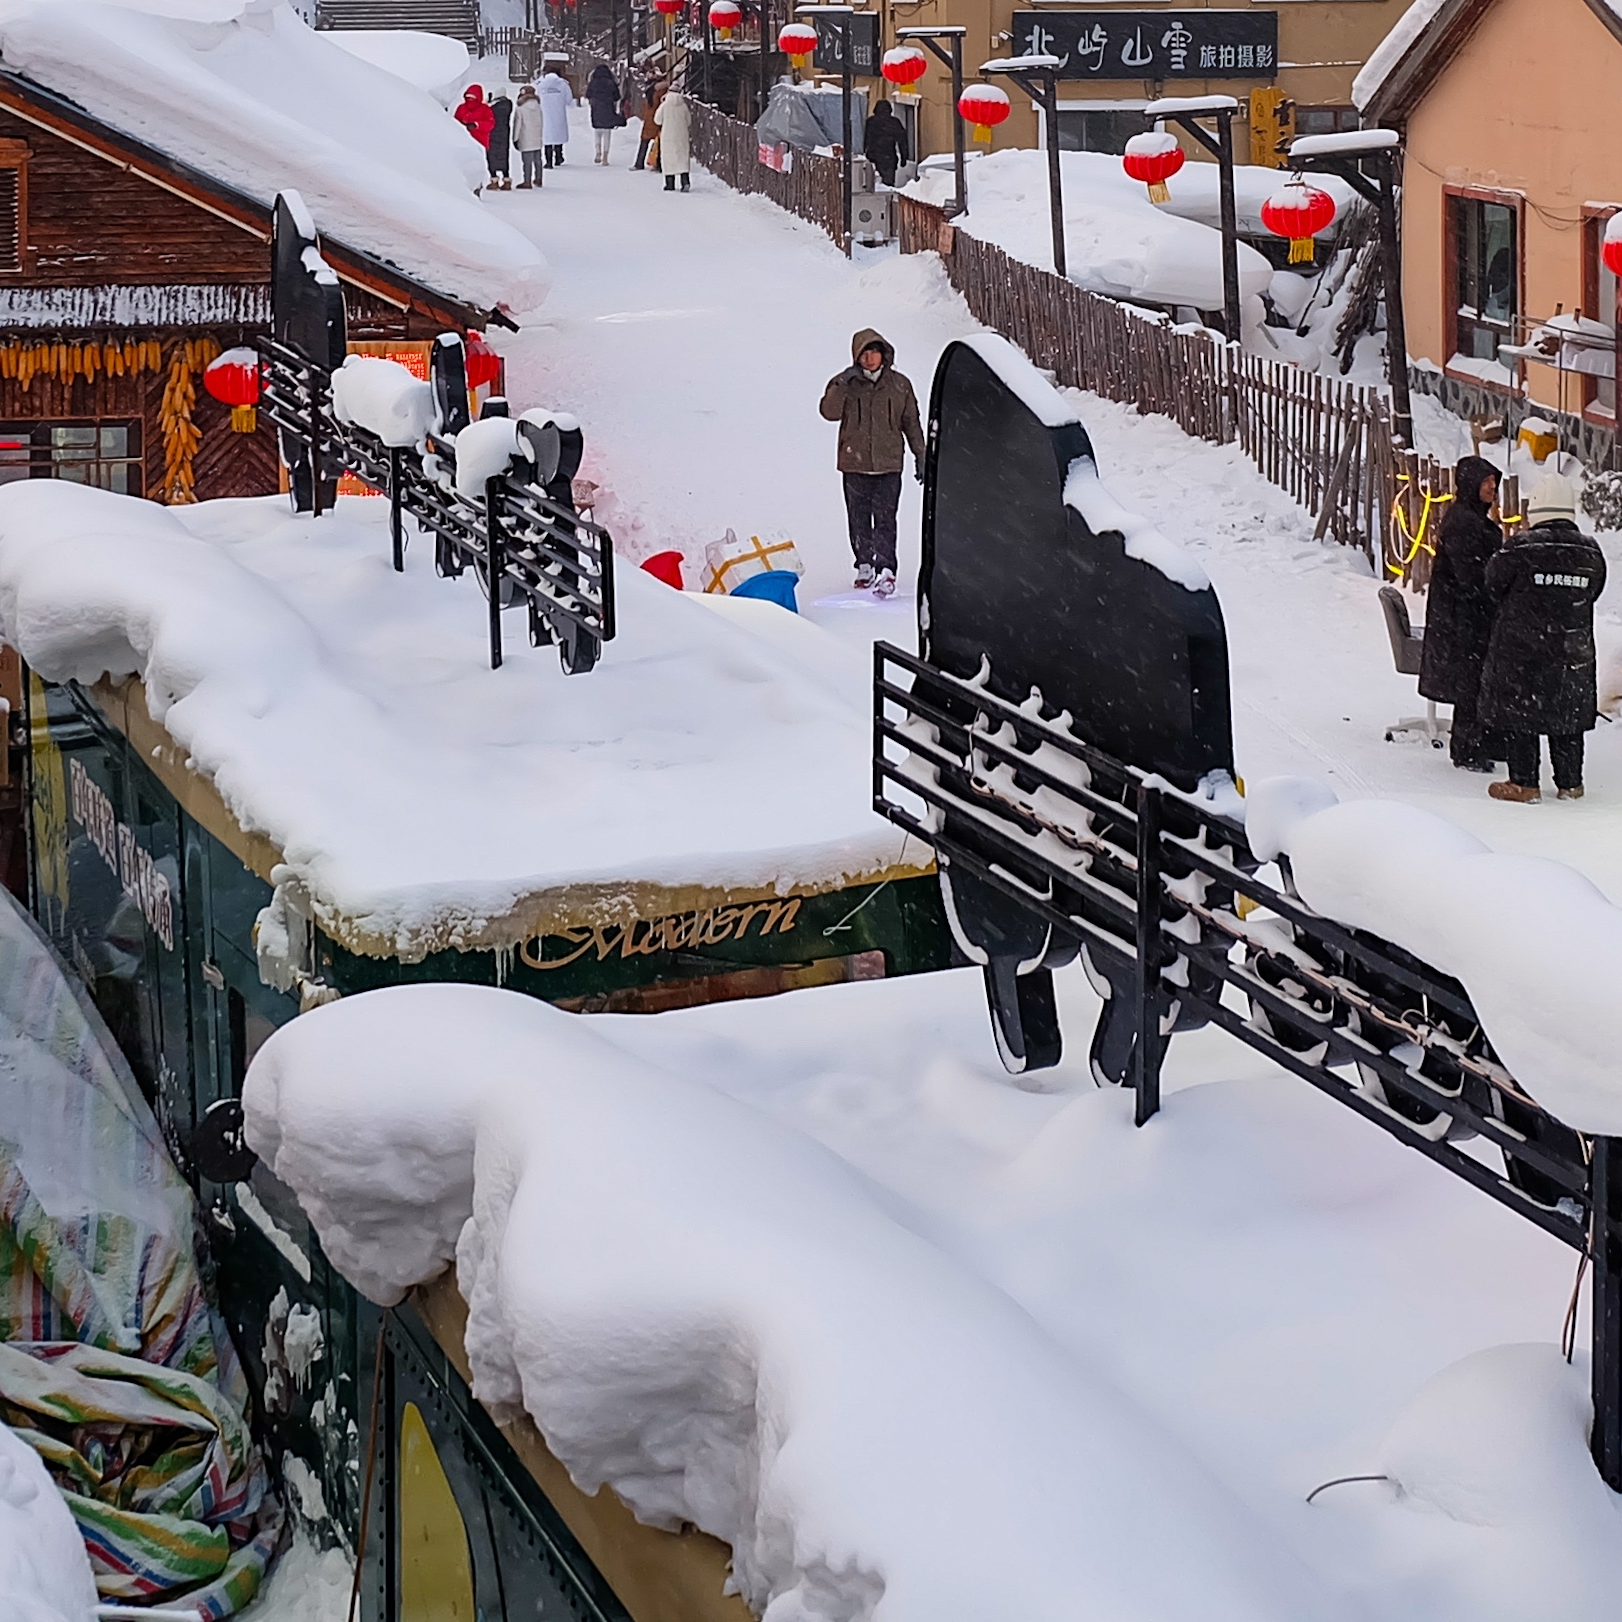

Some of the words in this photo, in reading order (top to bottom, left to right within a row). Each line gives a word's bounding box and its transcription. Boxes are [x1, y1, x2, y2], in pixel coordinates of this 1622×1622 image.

[1199, 44, 1274, 69] 旅拍摄影
[519, 895, 804, 971] Modern
